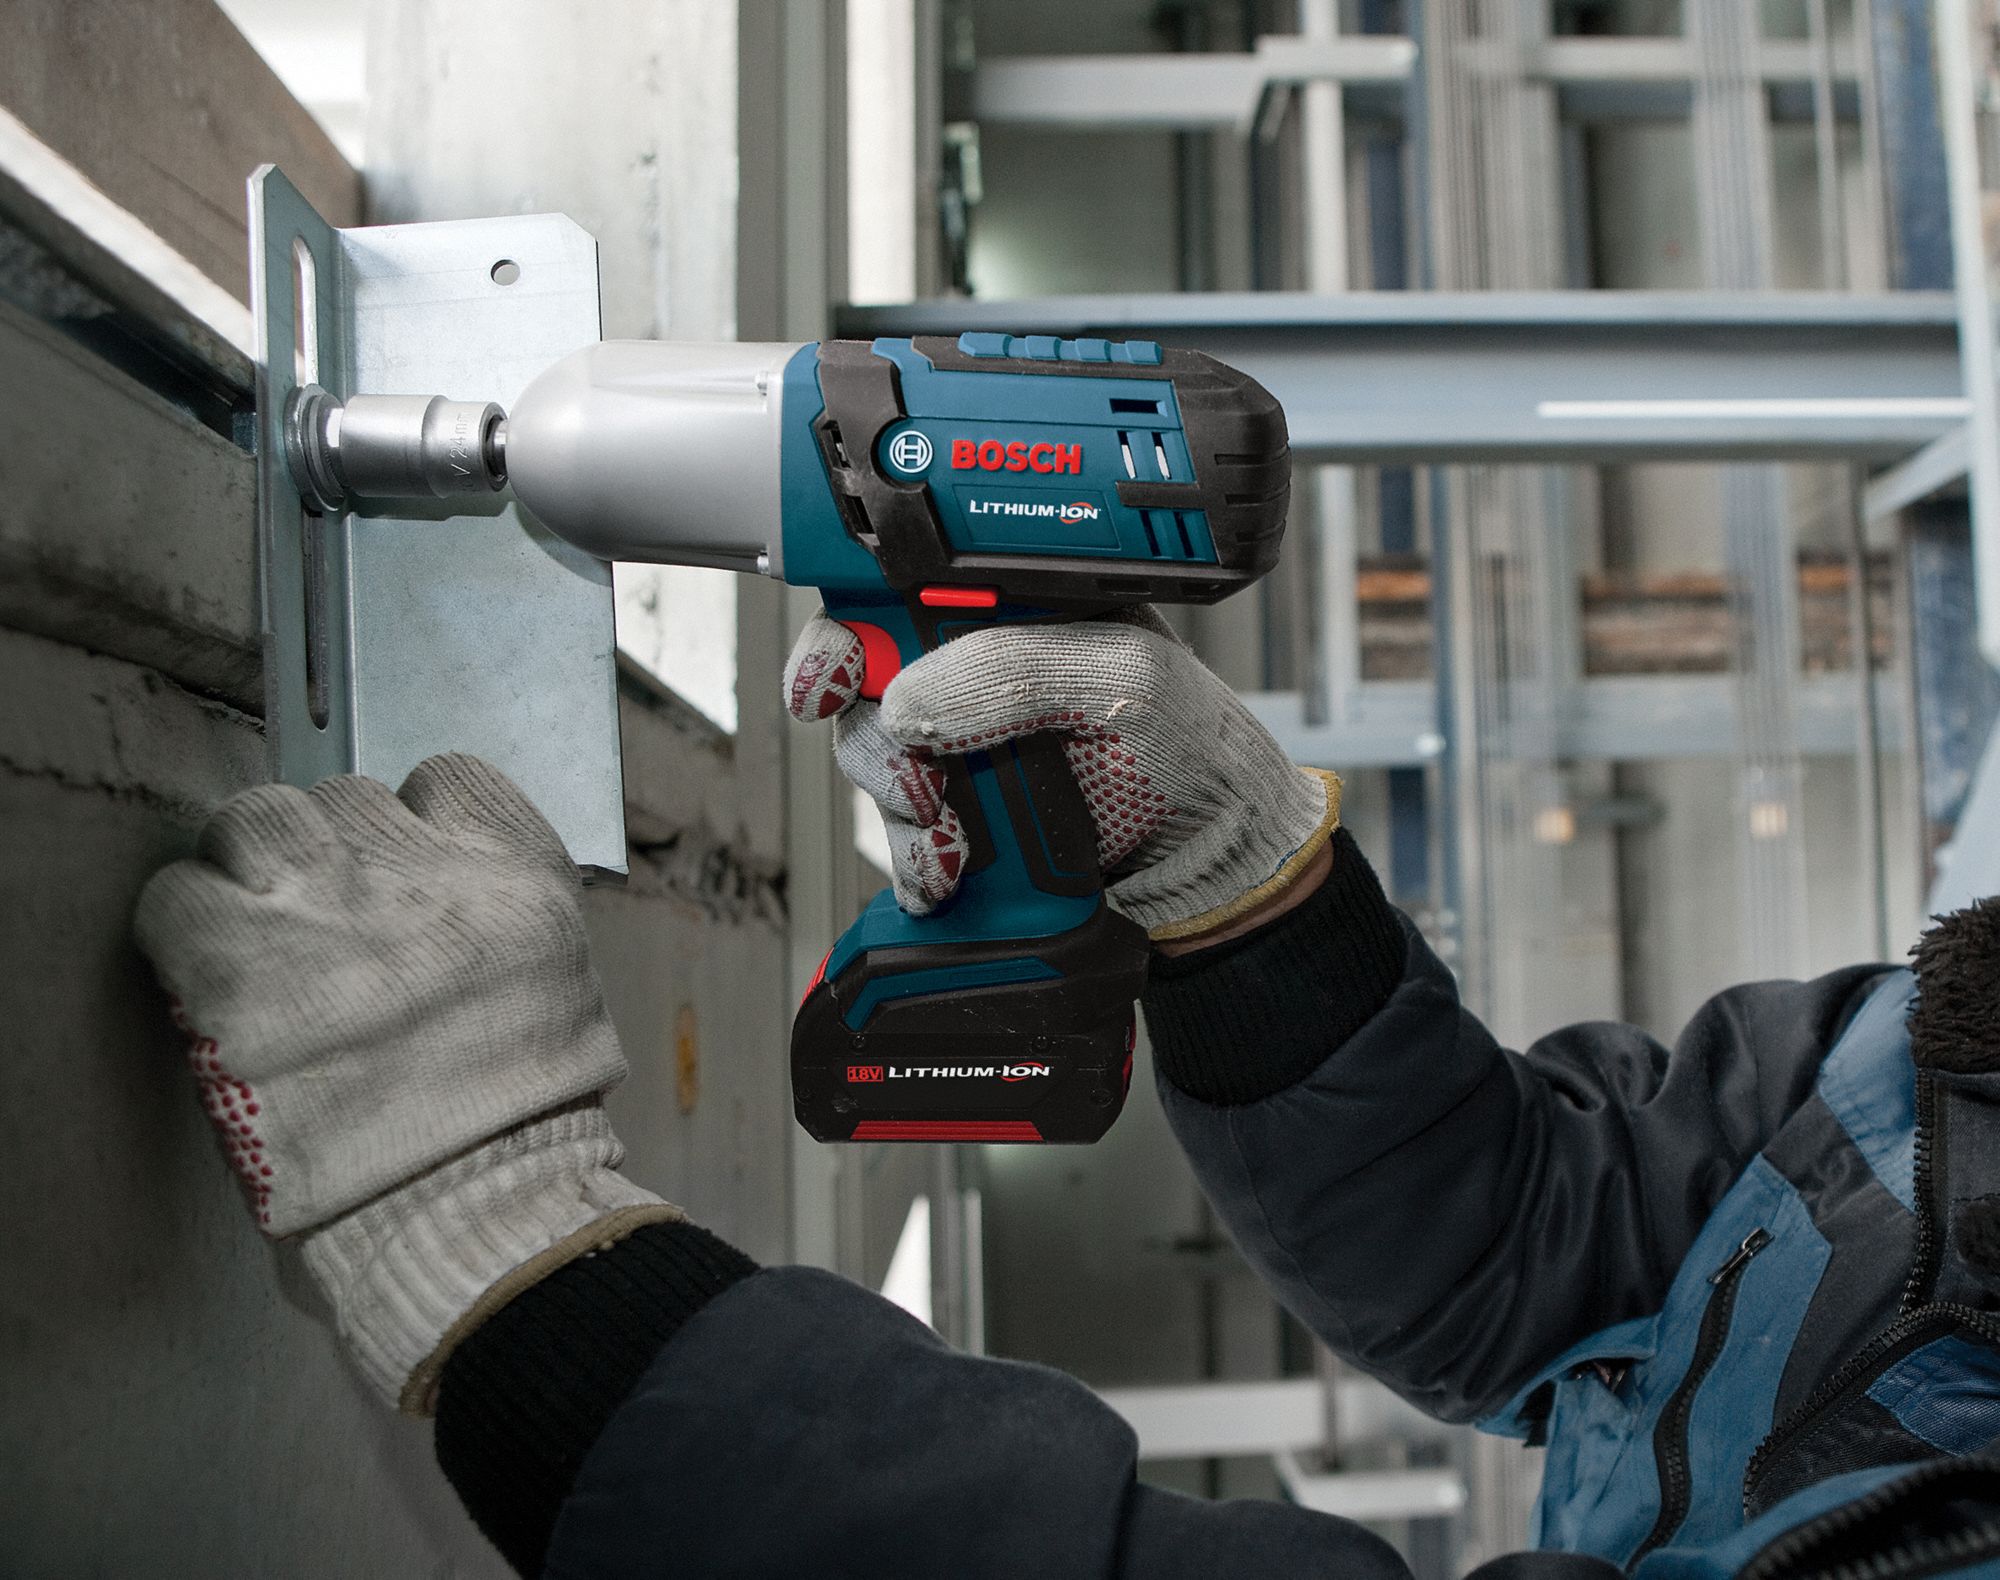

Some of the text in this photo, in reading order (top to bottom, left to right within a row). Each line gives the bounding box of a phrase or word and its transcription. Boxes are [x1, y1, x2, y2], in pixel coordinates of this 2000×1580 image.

[952, 440, 1081, 474] BOSCH
[969, 500, 1099, 519] LITHIUM-ION
[849, 1065, 1050, 1081] 18V LITHIUM-ION
